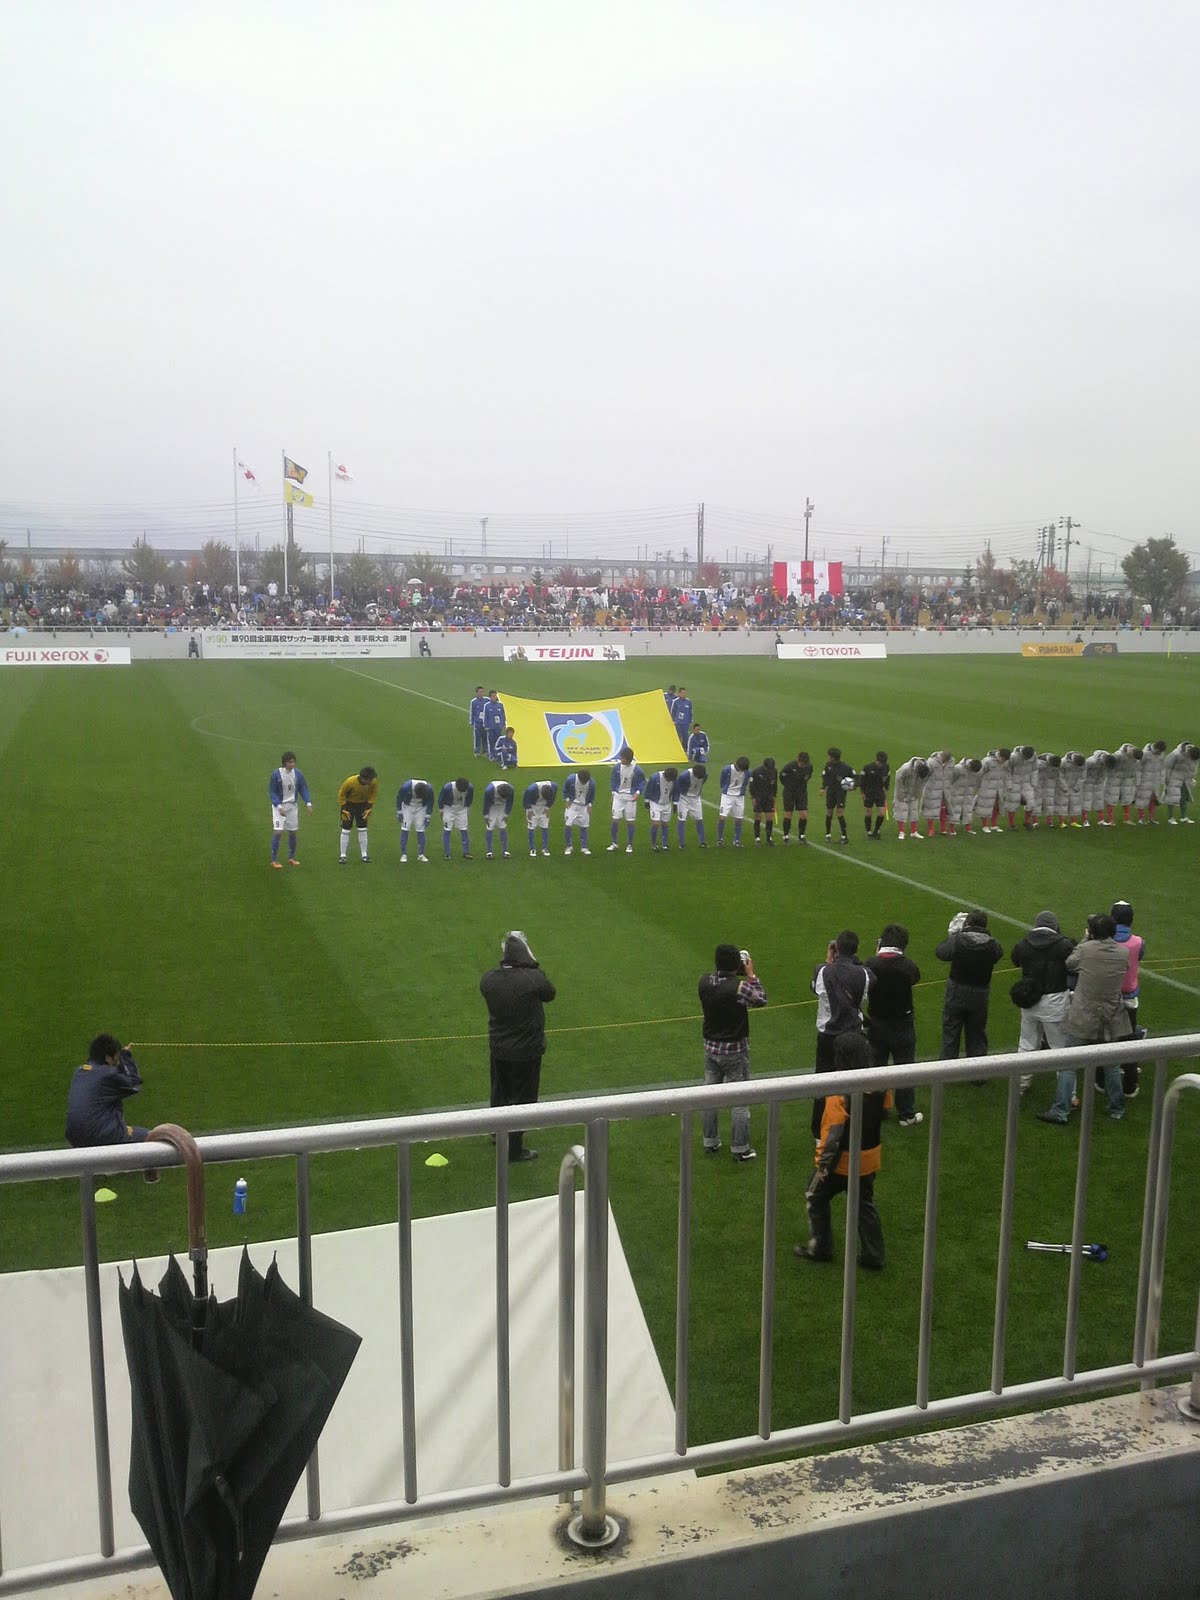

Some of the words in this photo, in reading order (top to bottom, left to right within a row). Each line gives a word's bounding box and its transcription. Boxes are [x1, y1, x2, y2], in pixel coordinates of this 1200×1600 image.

[231, 634, 350, 643] 第90回全国高校サッカー選手権大会
[354, 634, 389, 643] 岩手県大会
[5, 651, 37, 662] FUJI
[40, 650, 89, 661] xerox
[535, 648, 595, 659] TEIJIN
[820, 647, 861, 656] TOYOTA
[623, 776, 628, 784] 2
